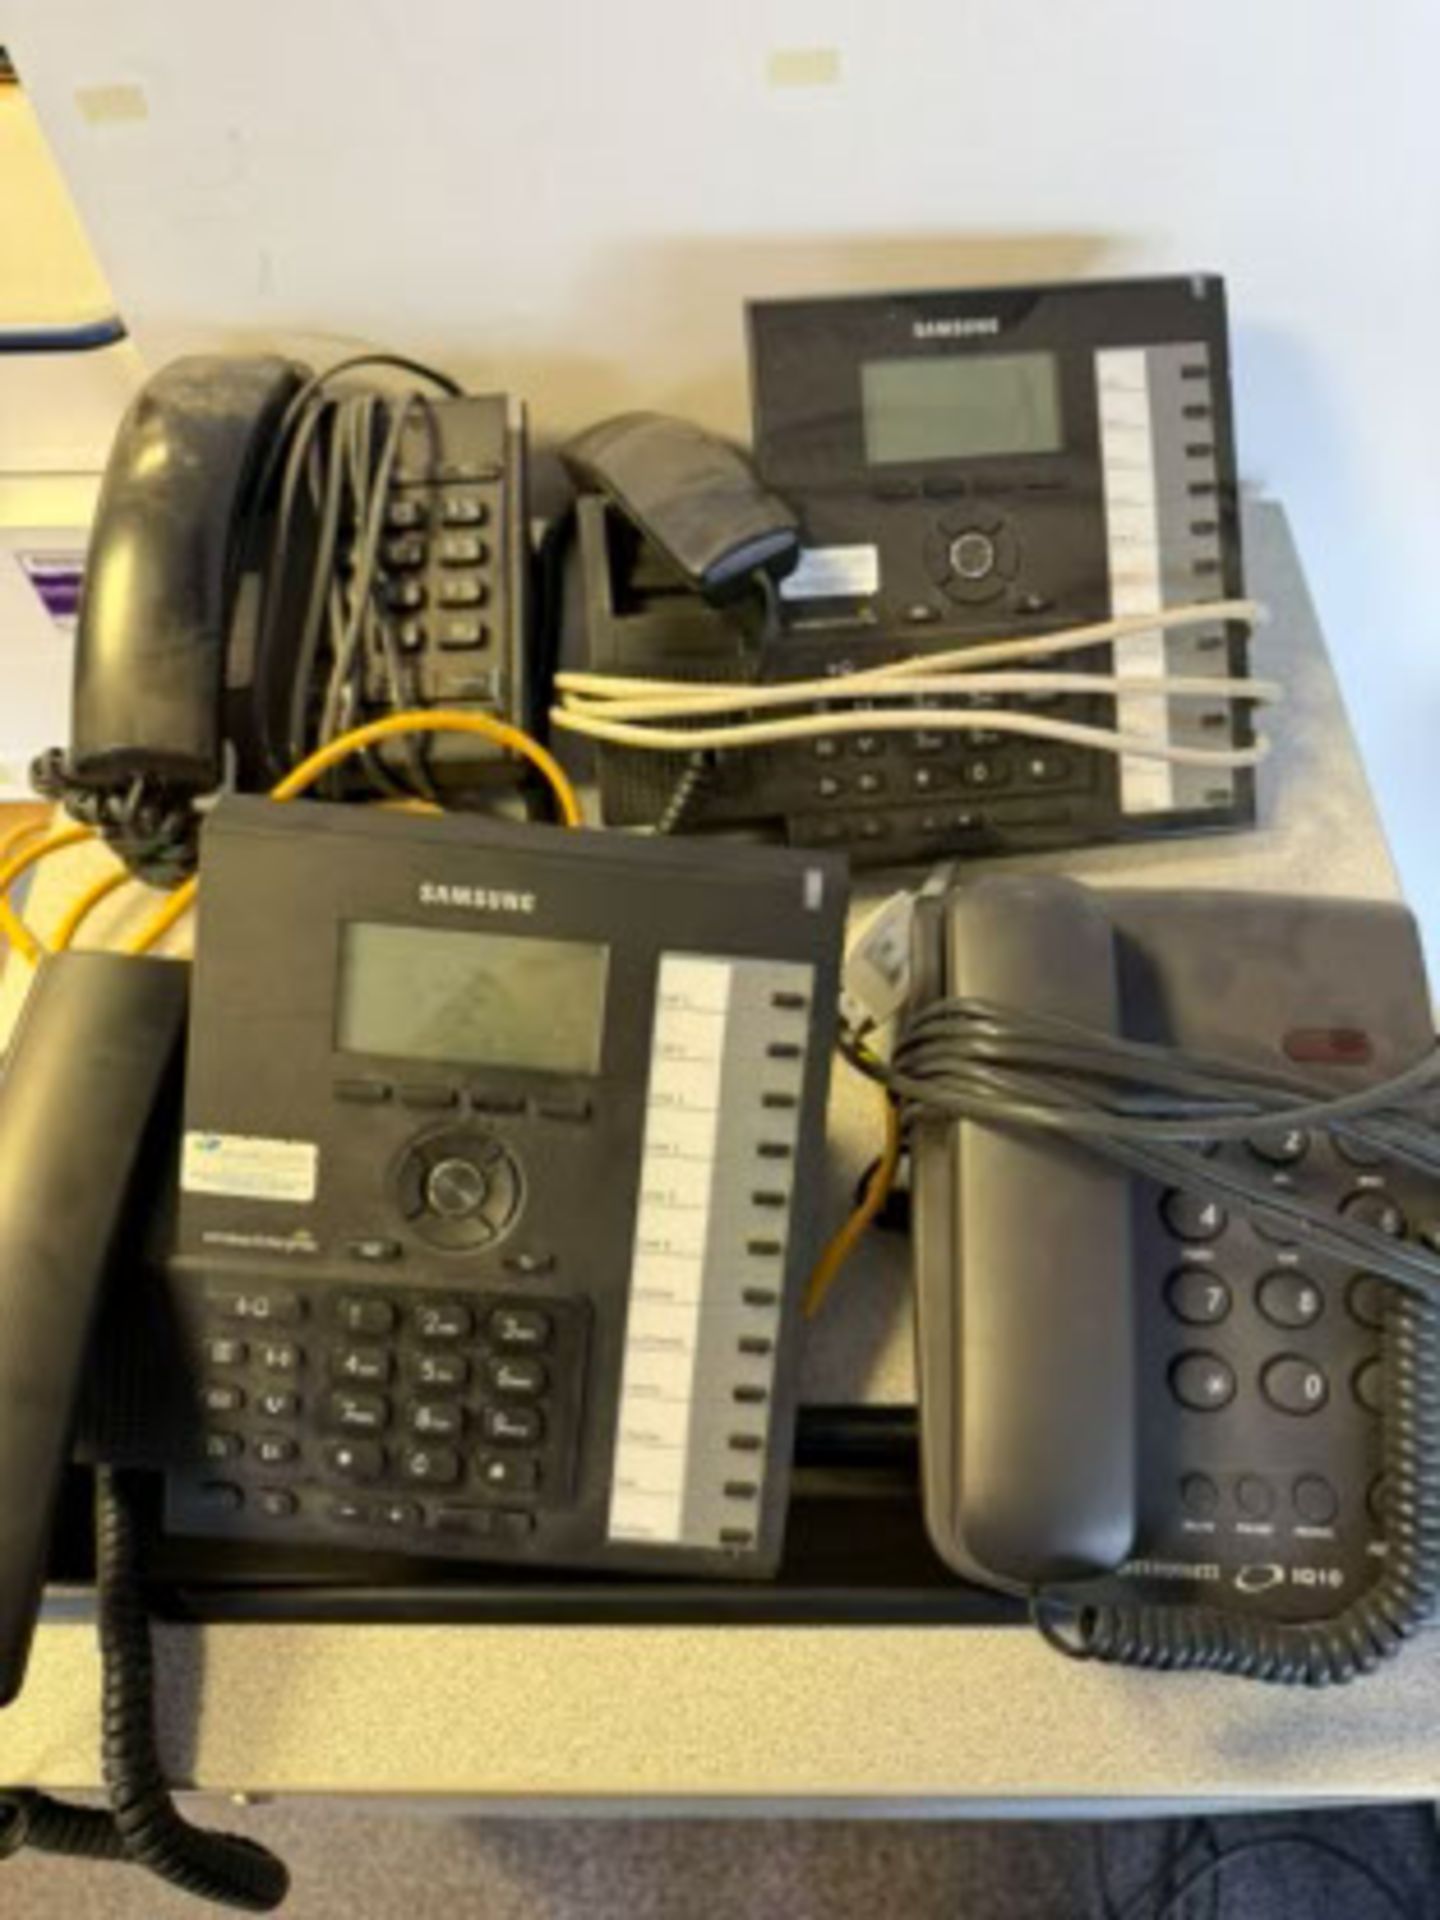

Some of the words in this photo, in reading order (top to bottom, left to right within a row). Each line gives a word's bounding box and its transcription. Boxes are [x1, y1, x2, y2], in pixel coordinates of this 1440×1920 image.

[418, 882, 537, 914] SAMSUNG
[1199, 1203, 1217, 1228] 4
[1206, 1287, 1223, 1312] 7
[1304, 1374, 1322, 1399] 0
